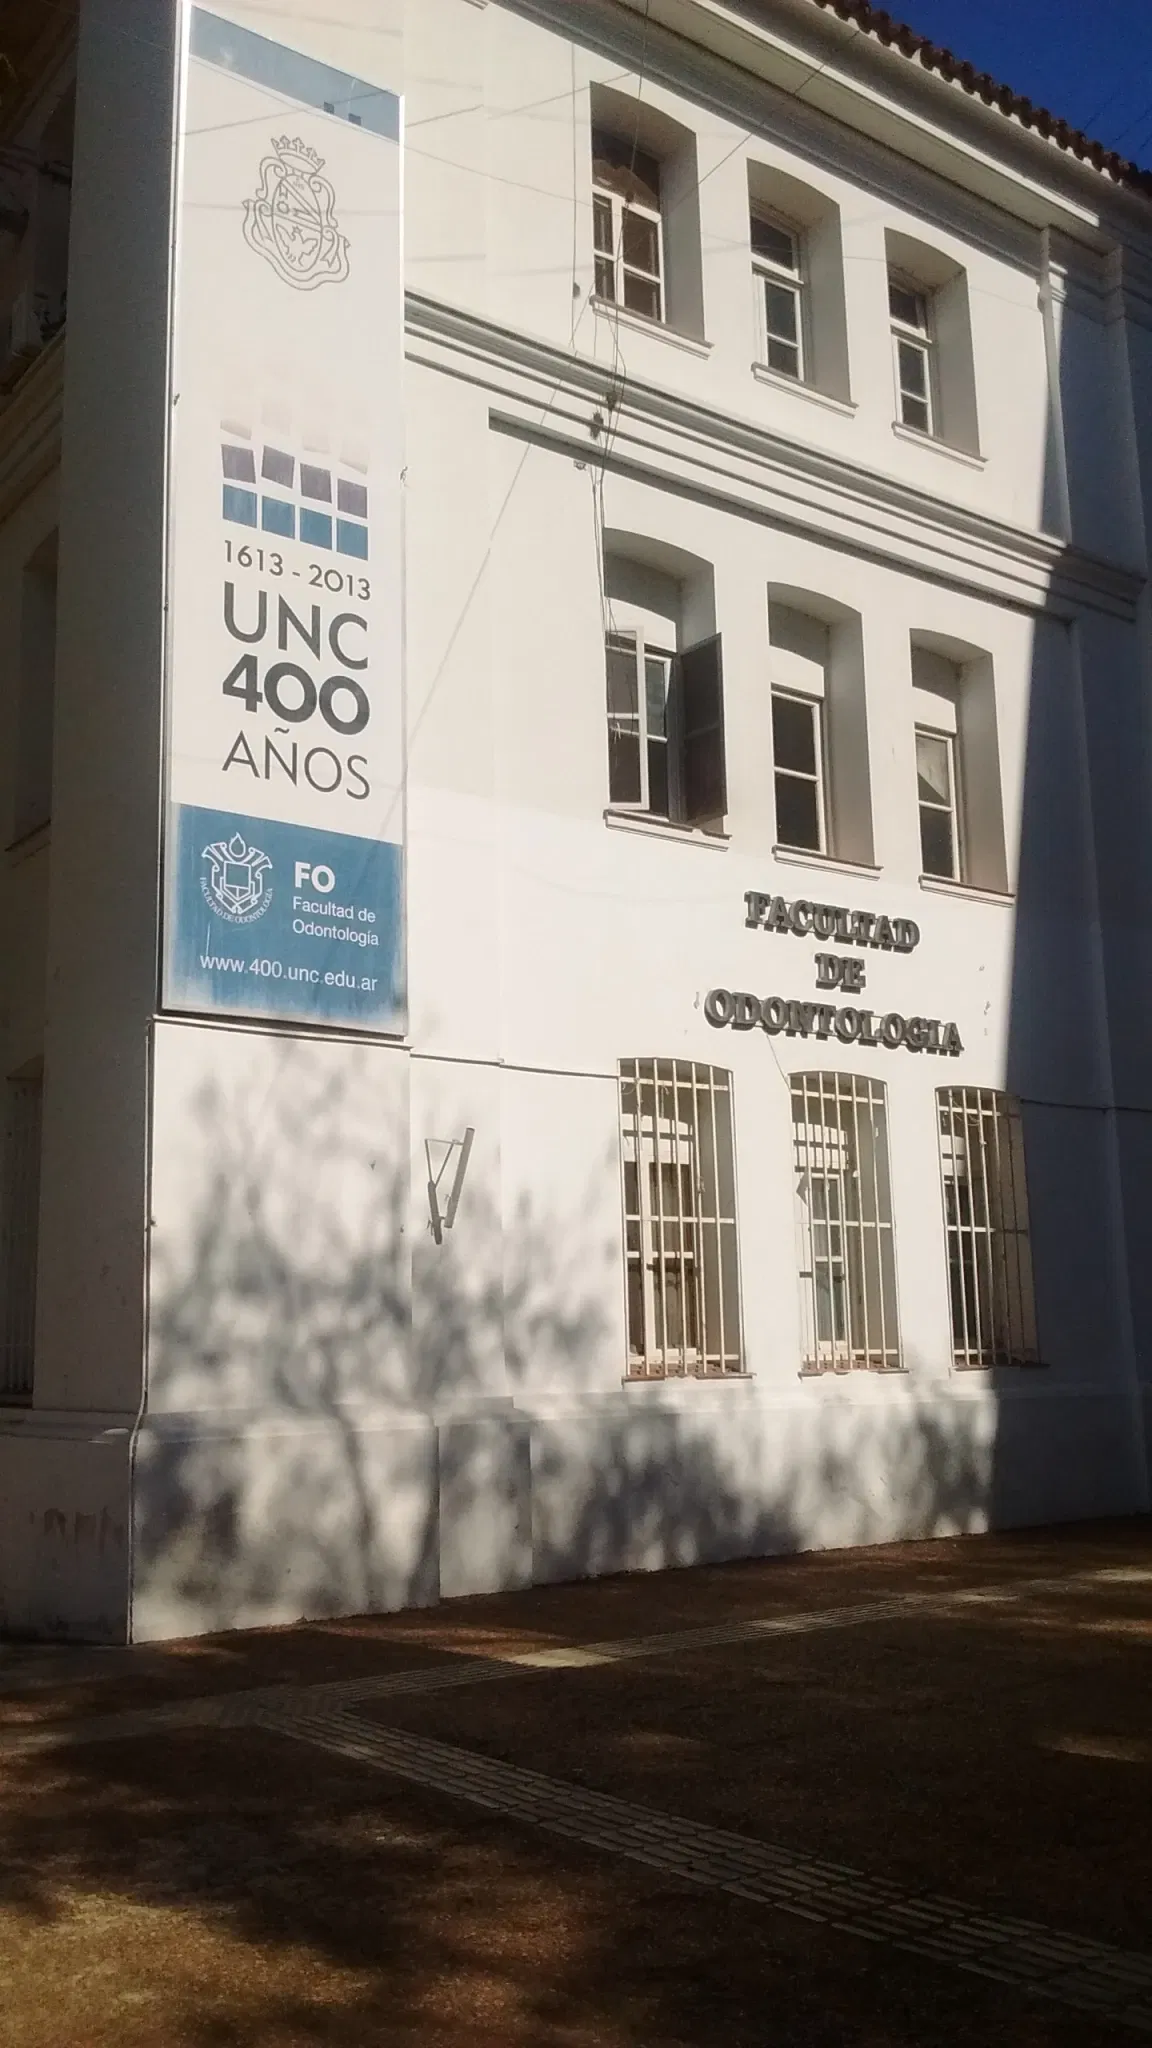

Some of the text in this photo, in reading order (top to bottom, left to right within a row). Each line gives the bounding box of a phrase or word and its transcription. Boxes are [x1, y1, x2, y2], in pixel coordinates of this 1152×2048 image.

[223, 580, 369, 671] UNC
[222, 653, 371, 736] 400
[221, 727, 371, 800] AÑOS
[294, 861, 336, 893] FO
[292, 896, 376, 923] Facultad de
[292, 918, 379, 947] Odontología
[743, 890, 921, 954] FACULTAD
[200, 954, 378, 992] www.400.unc.edu.ar
[814, 952, 867, 994] DE
[703, 988, 965, 1058] ODONTOLOGIA
